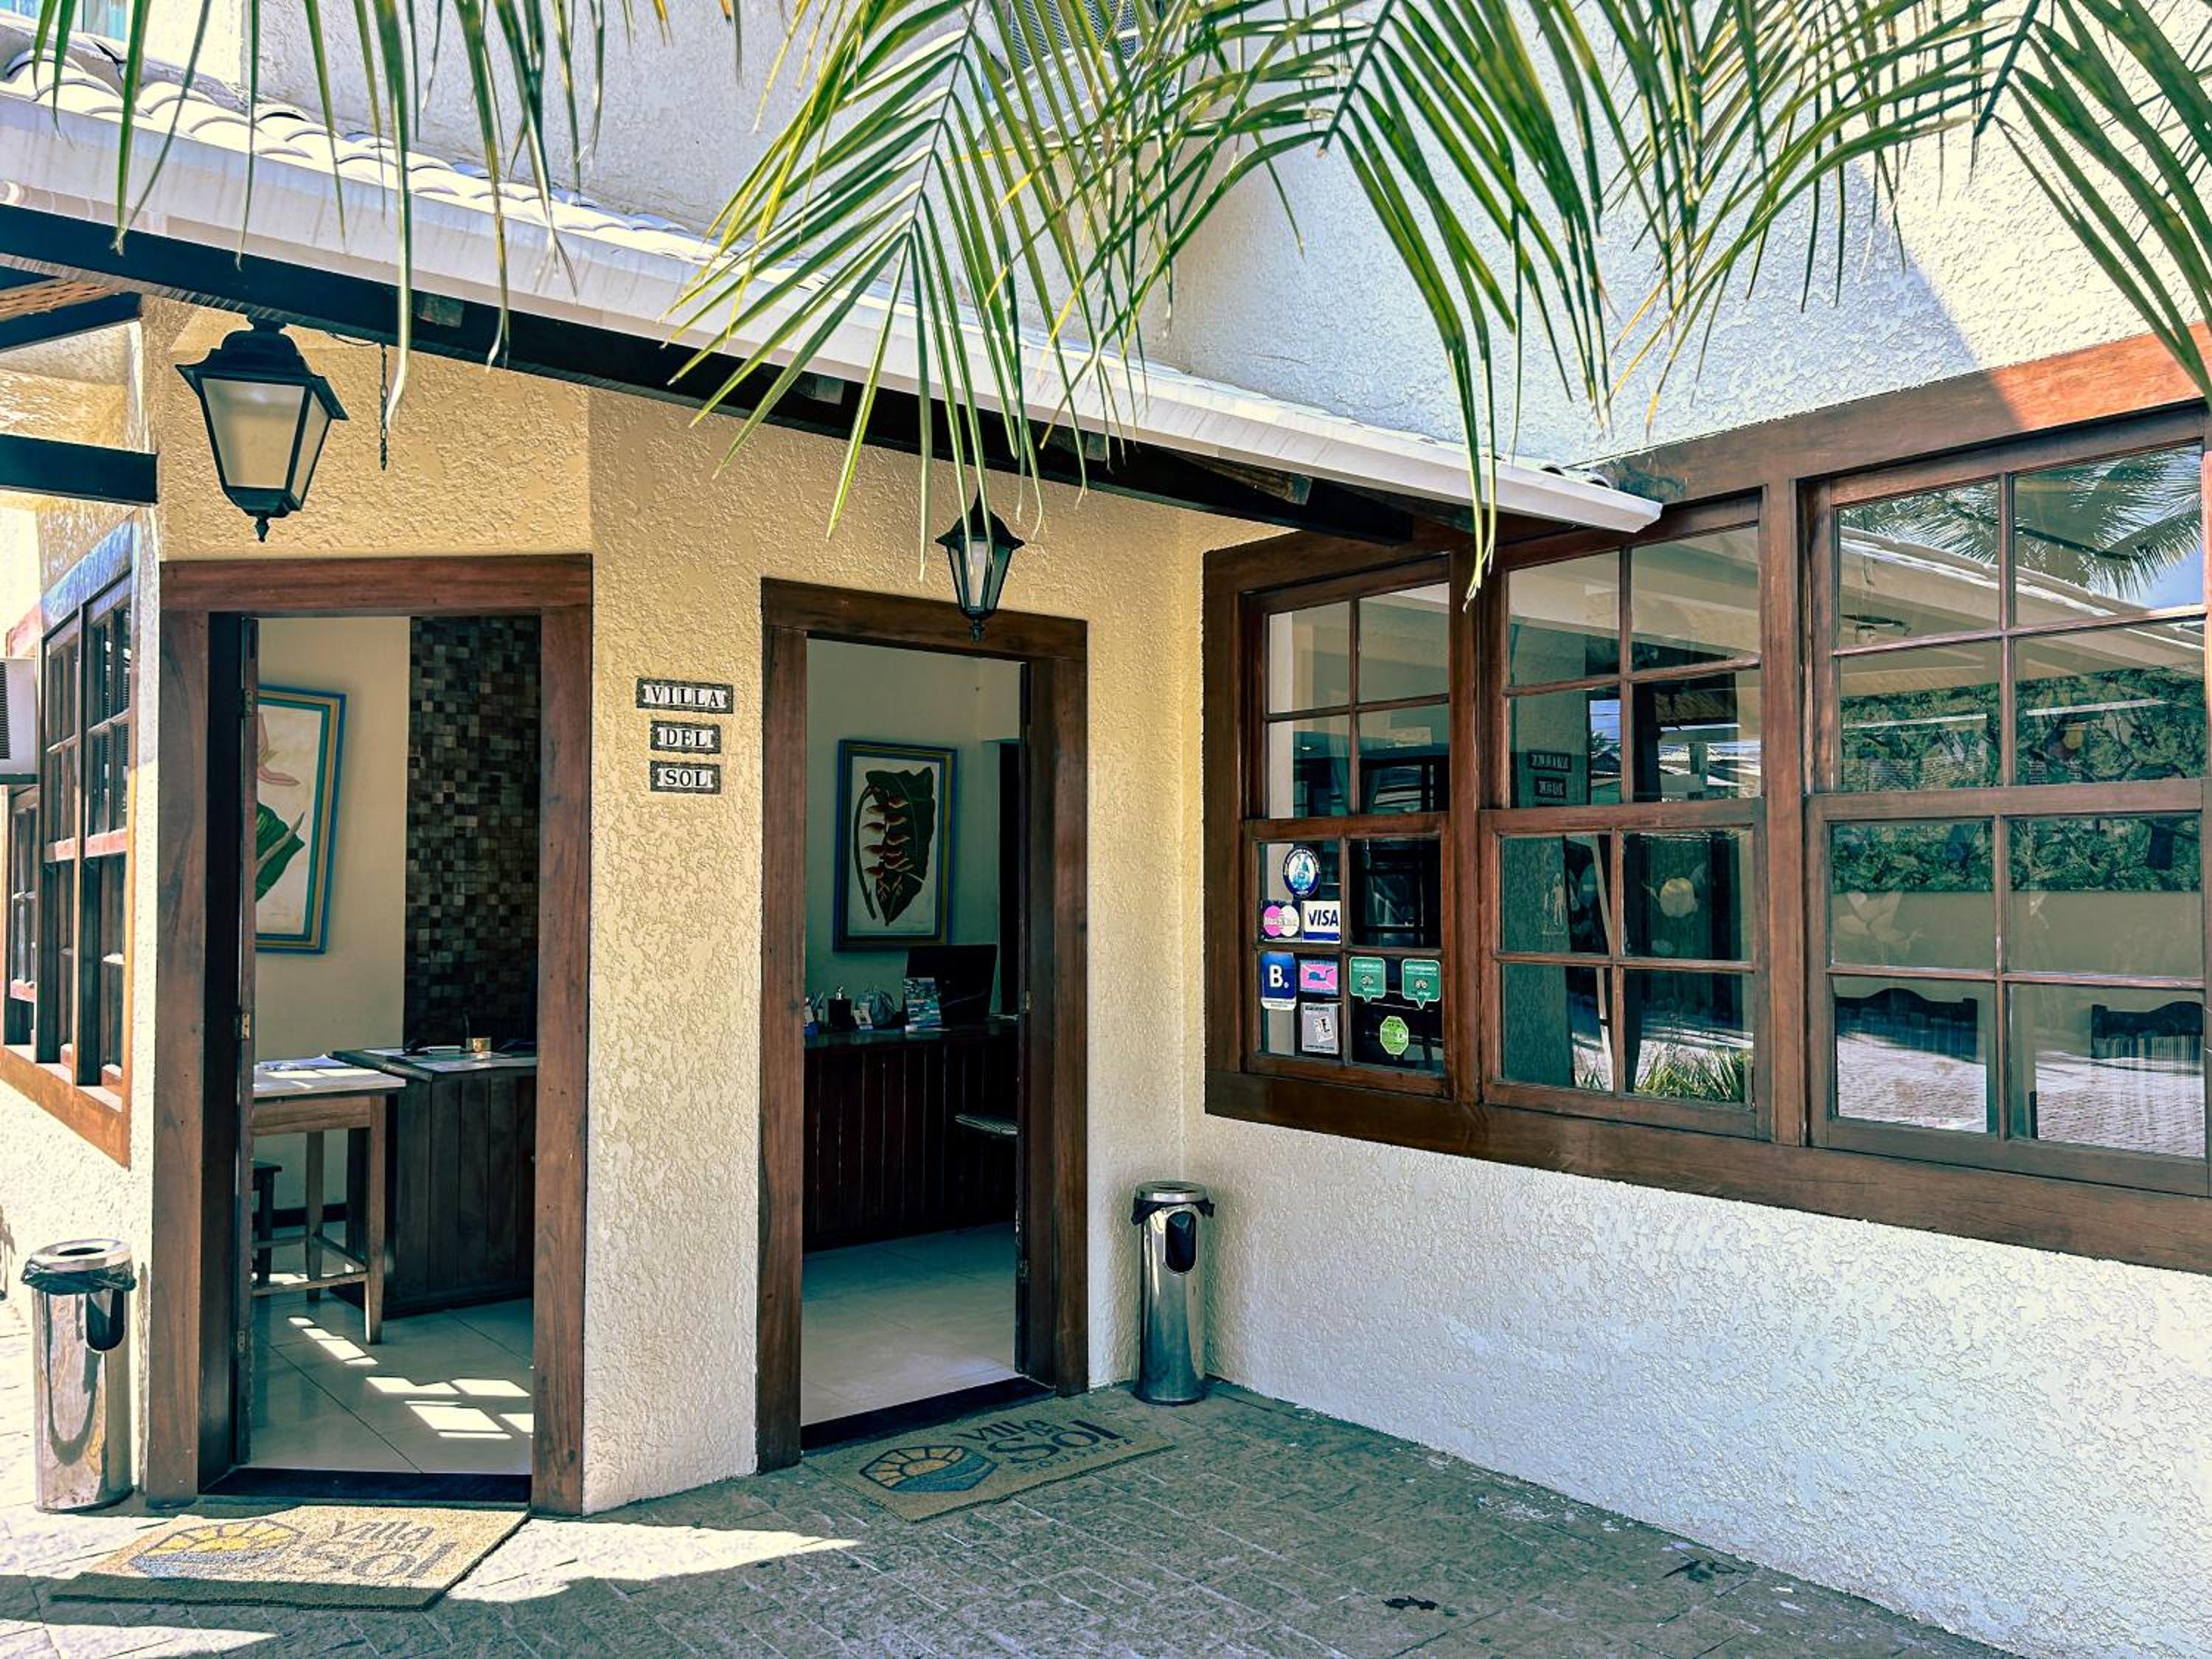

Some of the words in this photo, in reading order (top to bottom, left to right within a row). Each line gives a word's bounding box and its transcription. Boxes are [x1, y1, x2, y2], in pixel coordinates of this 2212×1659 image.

[651, 686, 720, 706] VILLA
[665, 729, 708, 746] DEL
[665, 769, 709, 787] SOL
[1308, 909, 1339, 927] VISA
[987, 1419, 1124, 1463] Sol
[331, 1520, 437, 1542] Villa
